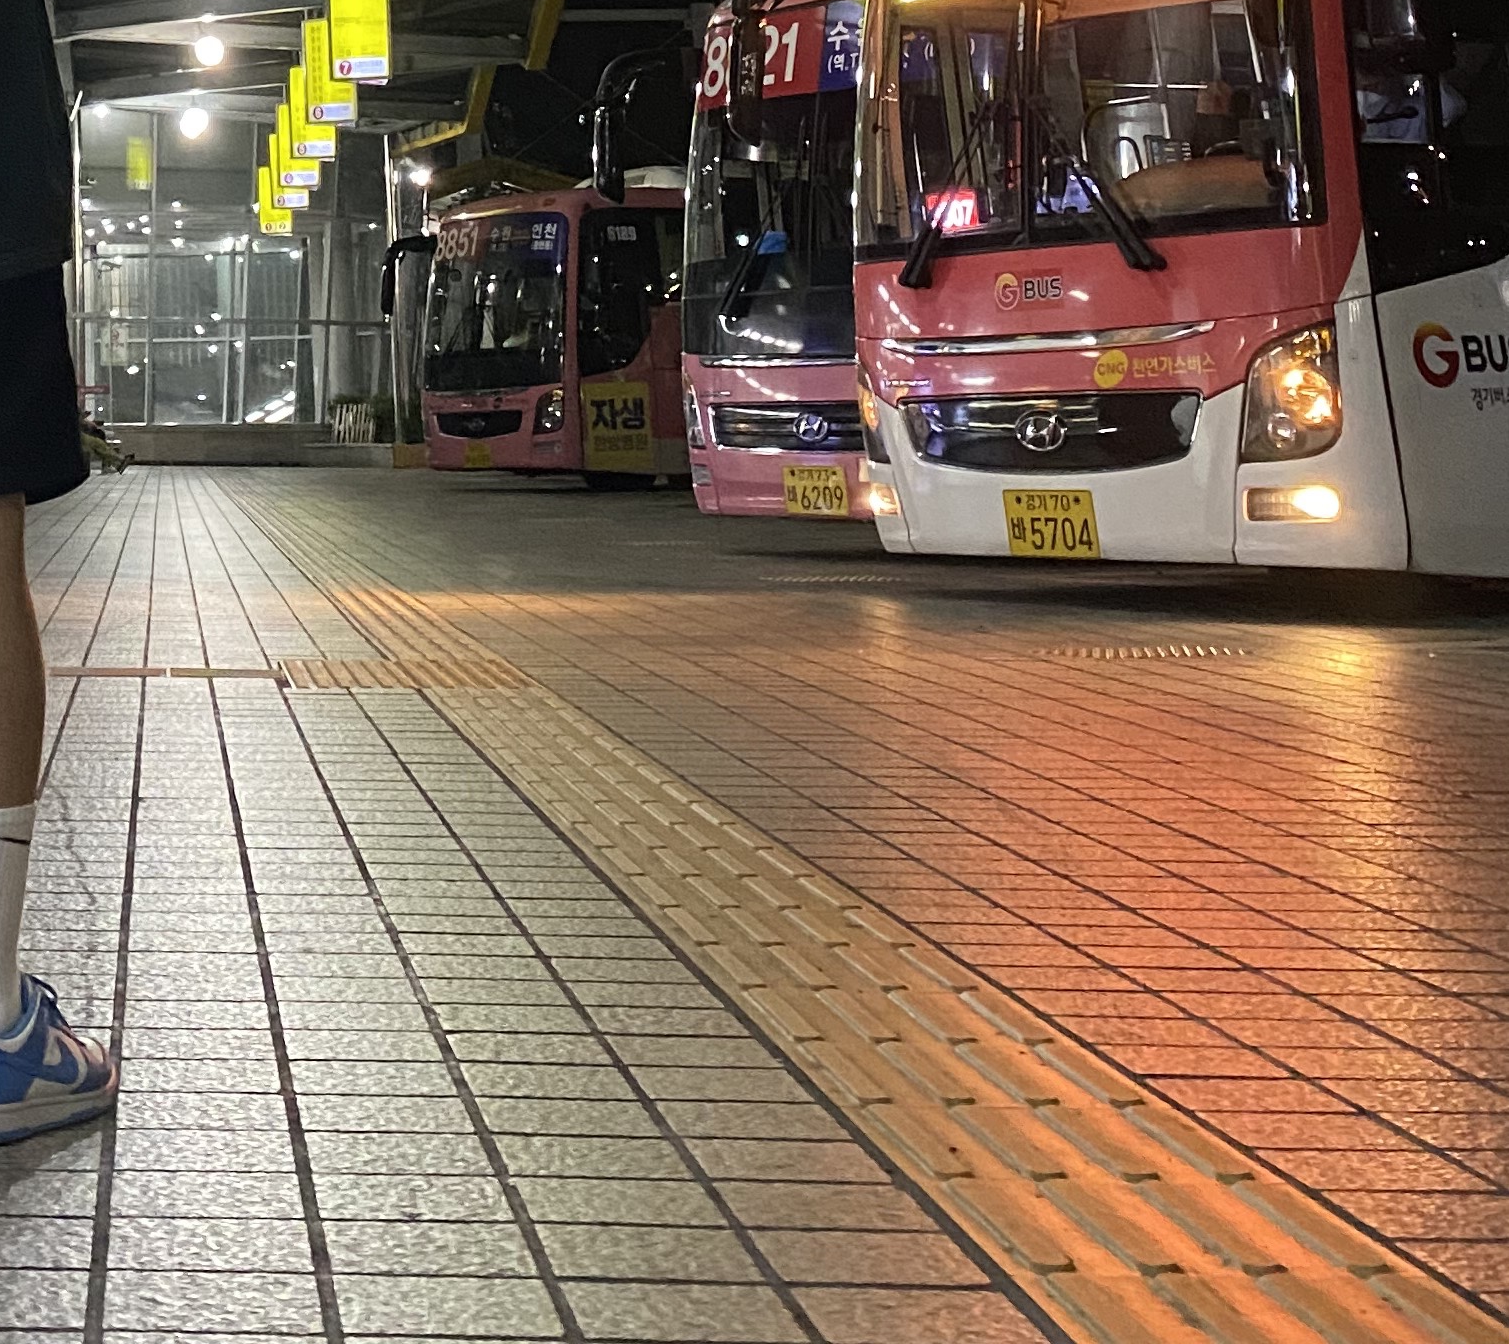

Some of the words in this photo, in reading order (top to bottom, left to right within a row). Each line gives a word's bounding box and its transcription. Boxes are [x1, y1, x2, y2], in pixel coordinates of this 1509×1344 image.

[341, 61, 350, 74] 7
[703, 21, 800, 98] 821
[435, 225, 478, 262] 8851
[531, 222, 558, 240] 인천
[1096, 362, 1126, 377] CNG
[1470, 386, 1509, 412] 경기버
[590, 397, 645, 431] 자생
